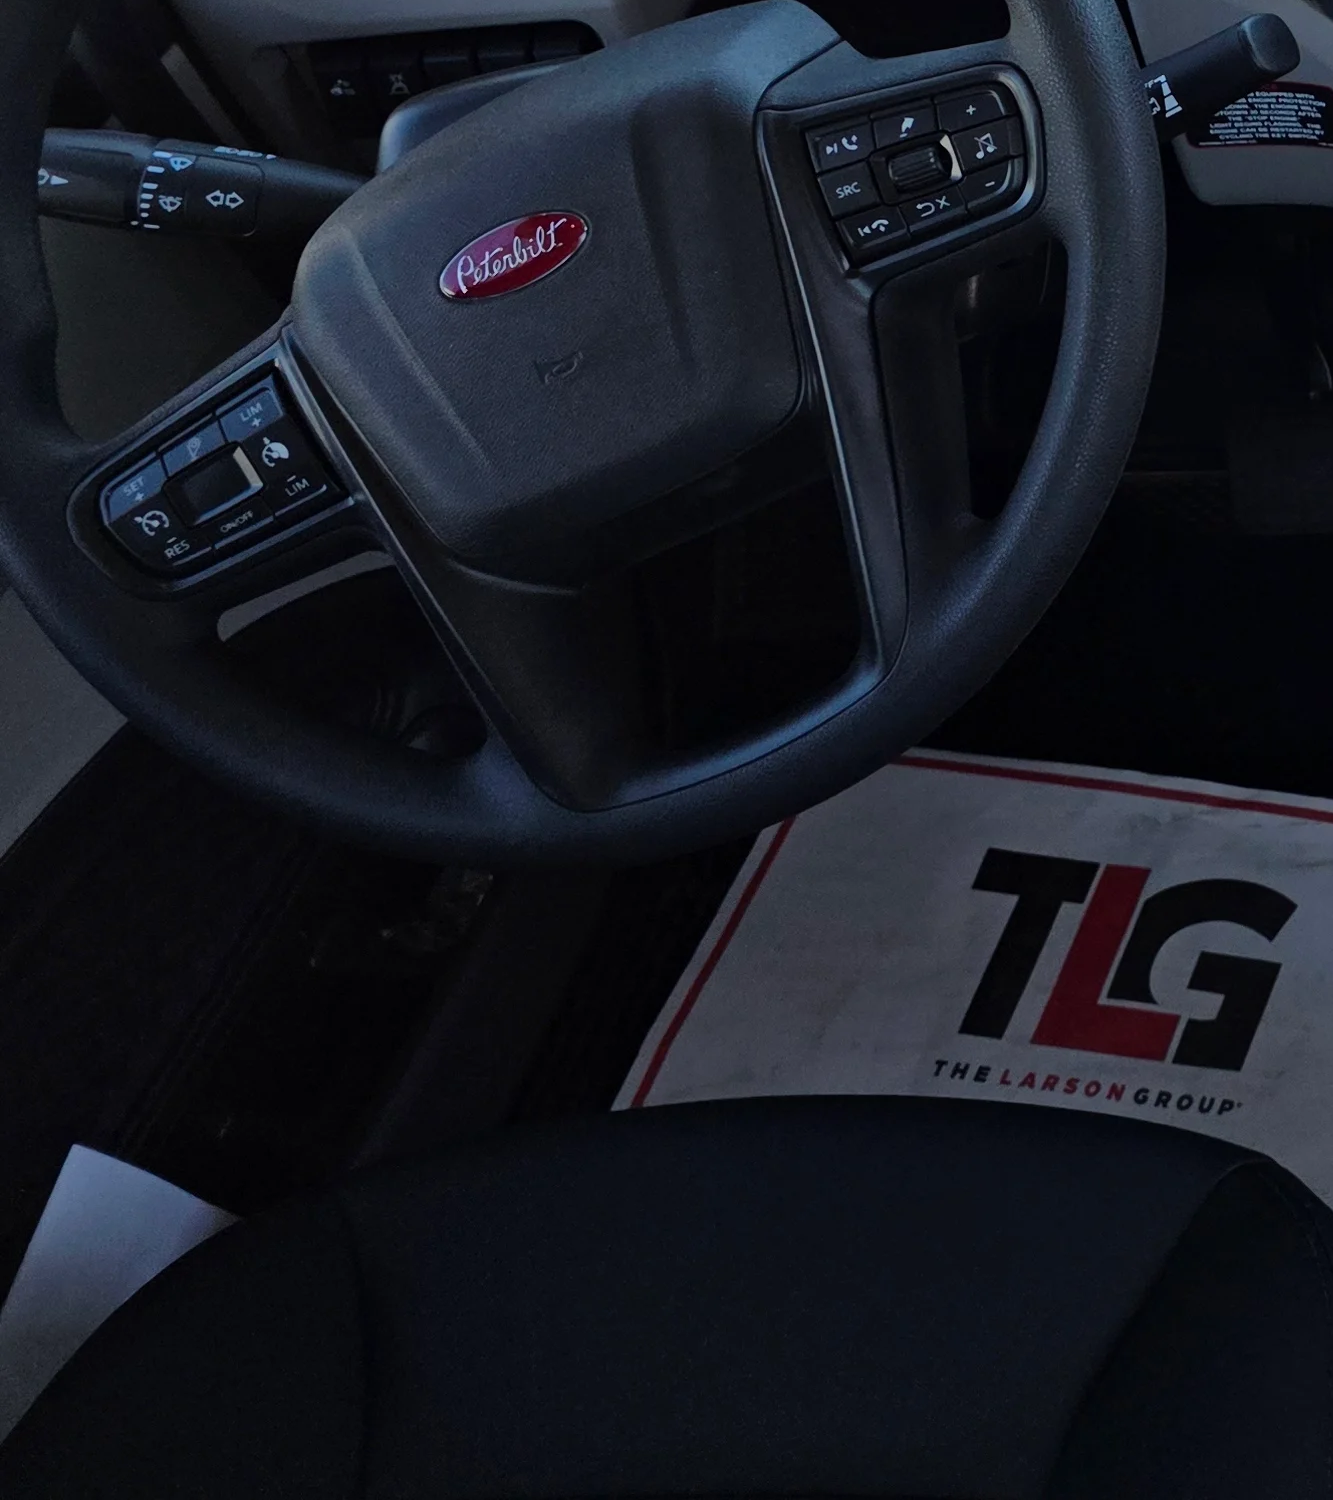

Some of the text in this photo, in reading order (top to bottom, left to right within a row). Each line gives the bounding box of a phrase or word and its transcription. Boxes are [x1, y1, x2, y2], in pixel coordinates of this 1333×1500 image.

[836, 182, 861, 199] SRC
[456, 218, 567, 294] Peterbilt
[240, 402, 263, 422] LIM
[123, 475, 146, 495] SET
[285, 477, 310, 497] LIM
[219, 509, 255, 533] ON/OFF
[164, 540, 191, 560] RES
[958, 847, 1299, 1072] TLG
[932, 1059, 991, 1084] THE
[1000, 1069, 1127, 1102] LARSON
